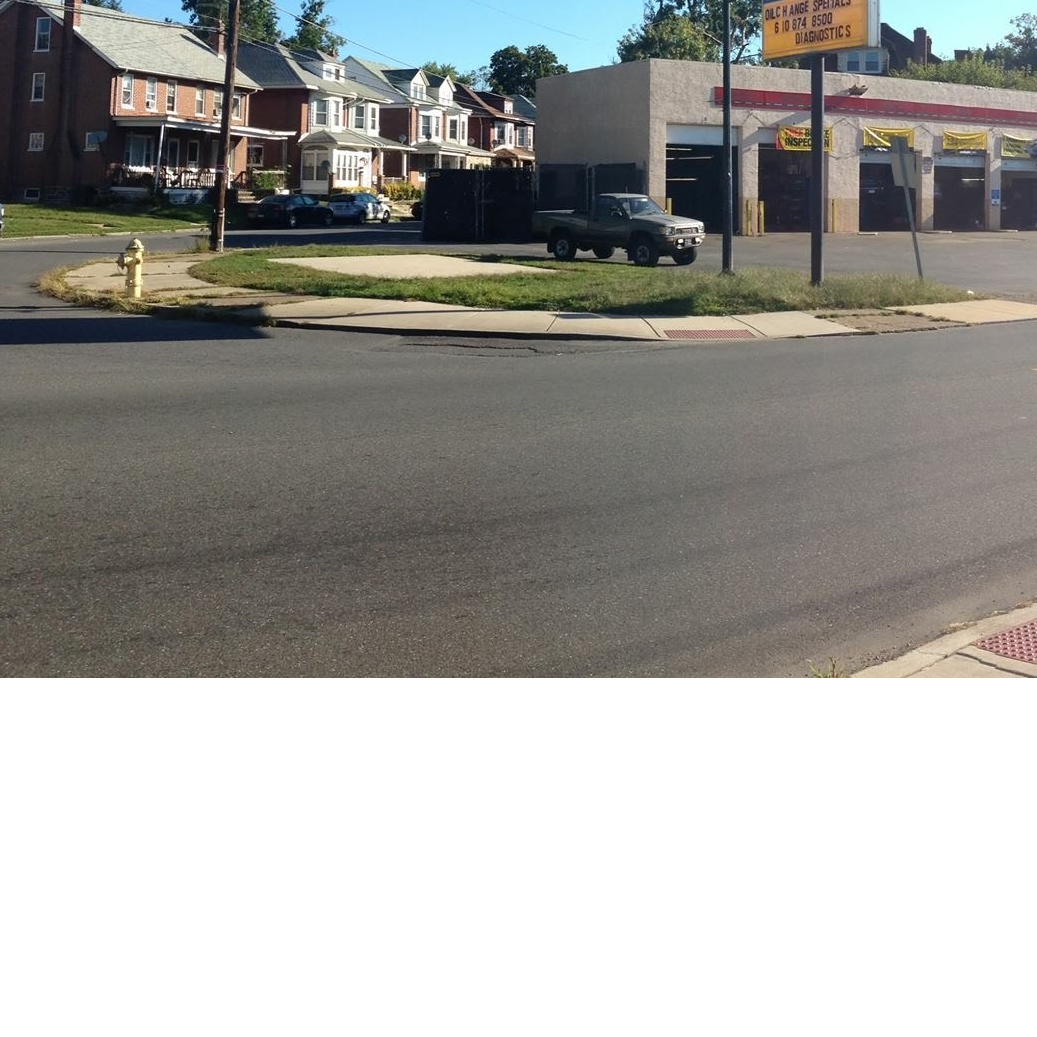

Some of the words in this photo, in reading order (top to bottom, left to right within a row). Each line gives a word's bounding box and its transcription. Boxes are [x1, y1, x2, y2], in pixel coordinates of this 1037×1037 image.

[792, 16, 807, 31] 874
[811, 12, 833, 27] 8500
[795, 24, 852, 45] DIAGNOSTICS
